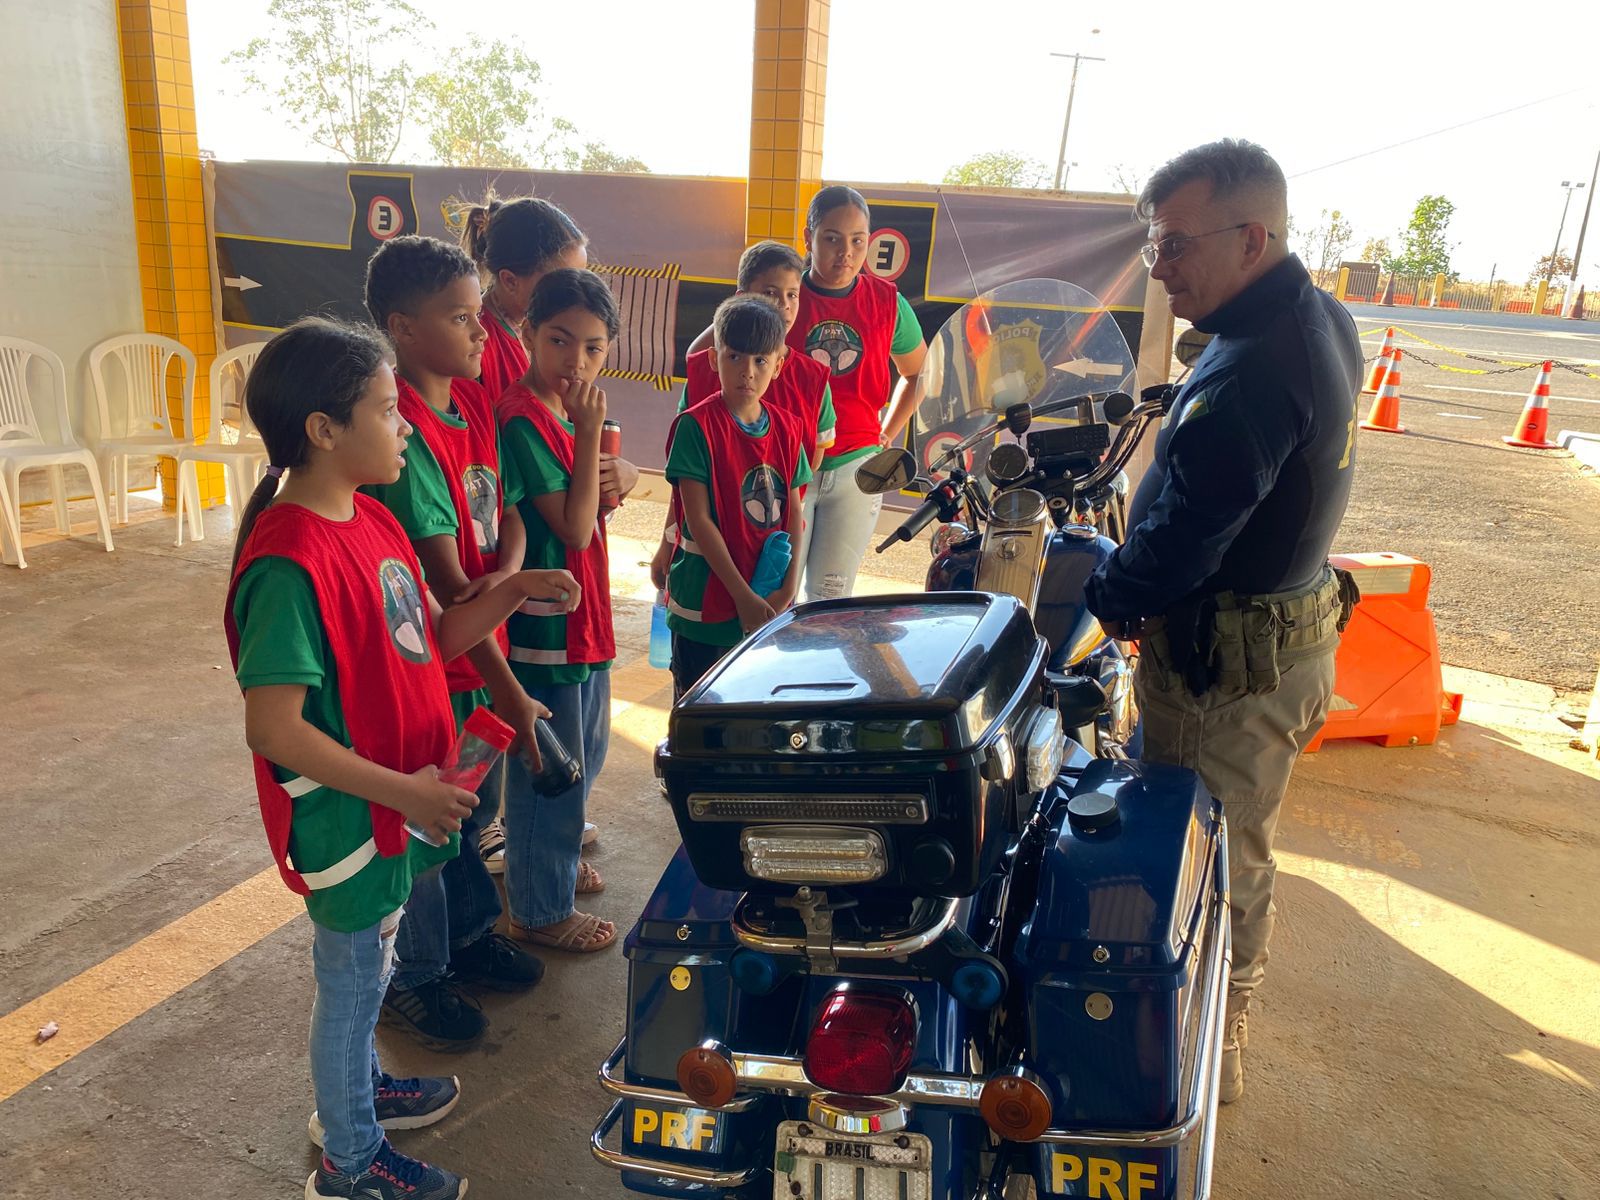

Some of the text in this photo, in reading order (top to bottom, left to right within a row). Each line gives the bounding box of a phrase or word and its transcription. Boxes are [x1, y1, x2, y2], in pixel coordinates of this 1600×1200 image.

[633, 1108, 716, 1151] PRF
[825, 1141, 875, 1161] BRASIL
[1052, 1152, 1158, 1200] PRF
